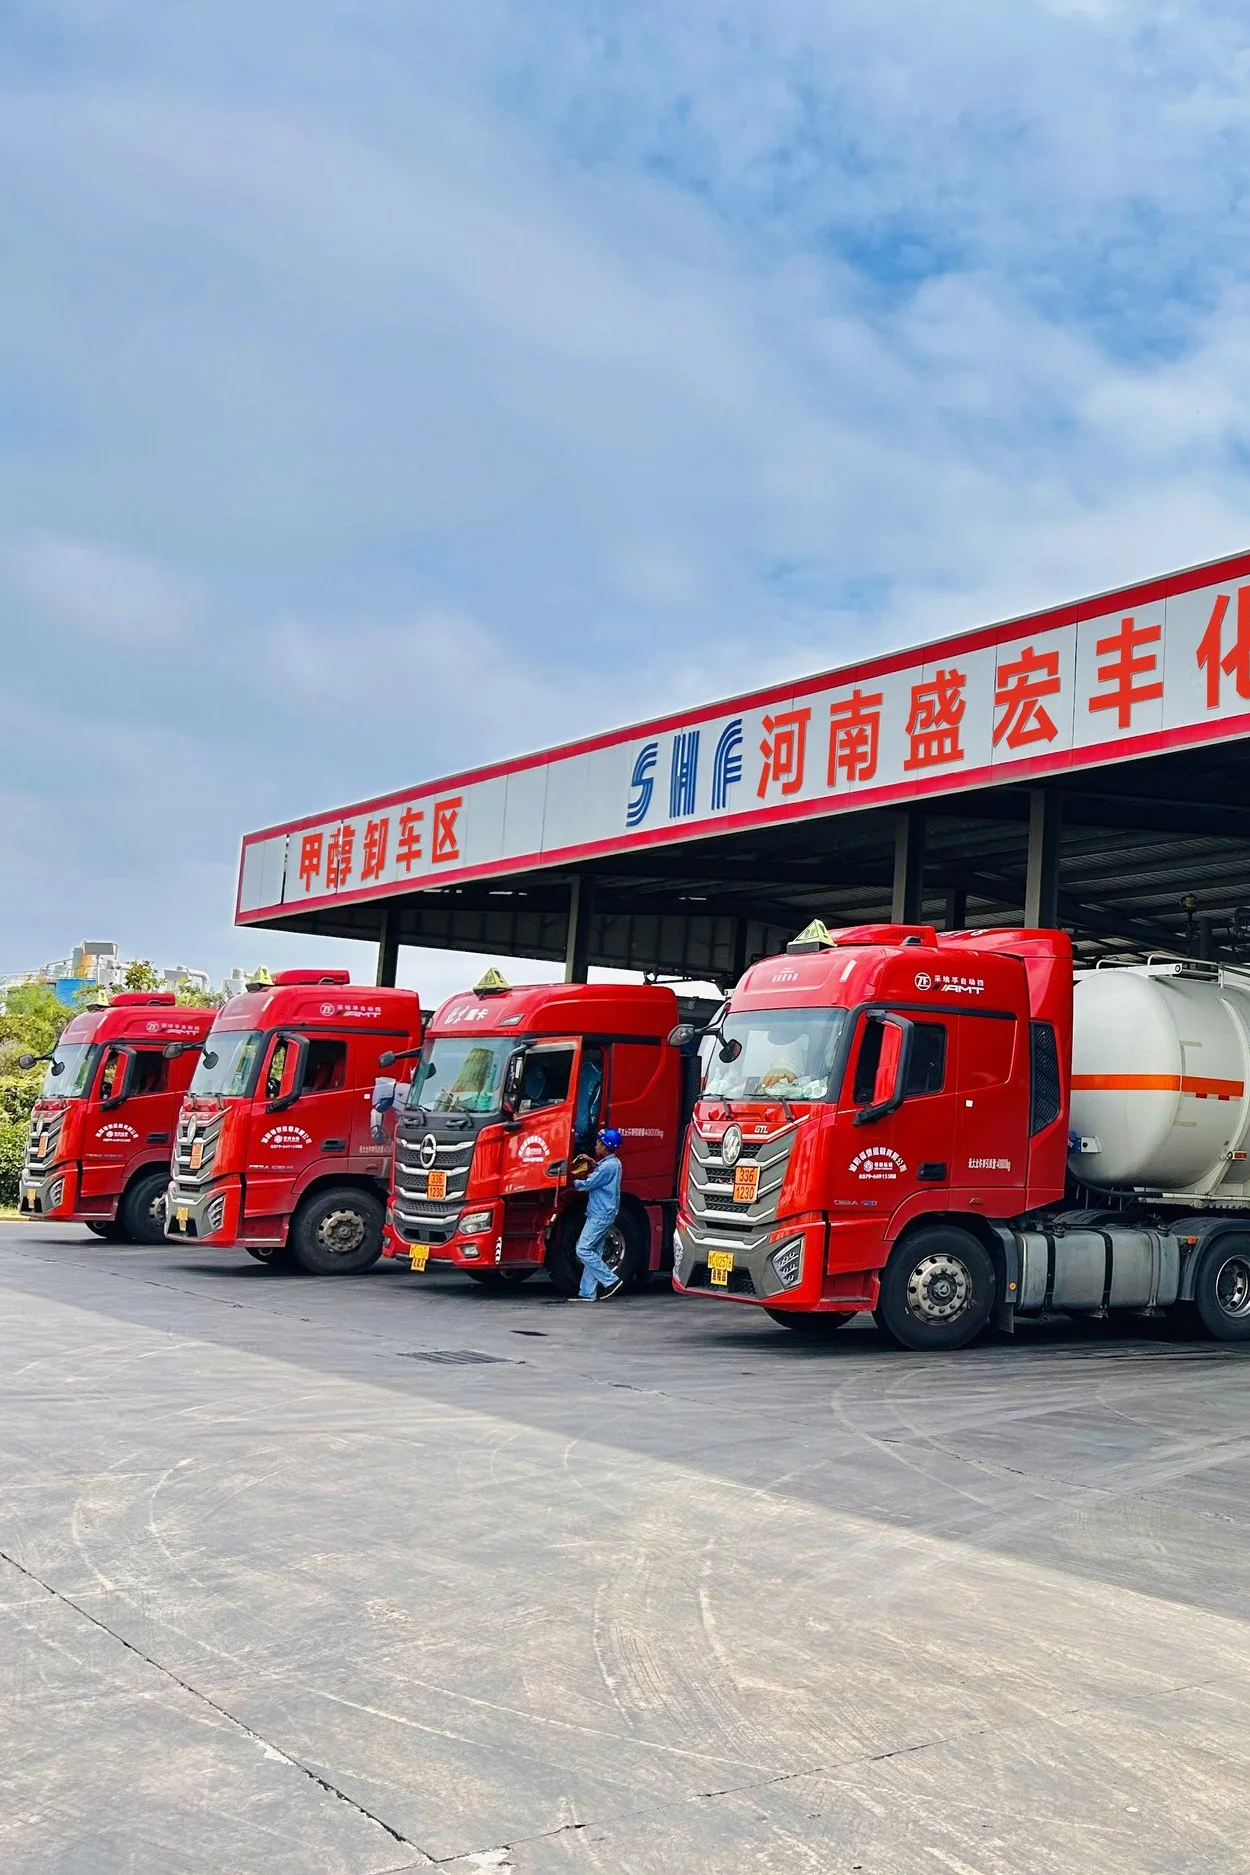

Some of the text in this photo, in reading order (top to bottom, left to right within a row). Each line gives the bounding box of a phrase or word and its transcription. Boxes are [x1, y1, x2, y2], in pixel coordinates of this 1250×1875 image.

[625, 718, 744, 827] SHF
[298, 795, 464, 893] 甲醇卸车区
[738, 1171, 755, 1183] 336
[429, 1187, 443, 1198] 1230
[735, 1186, 755, 1201] 1230
